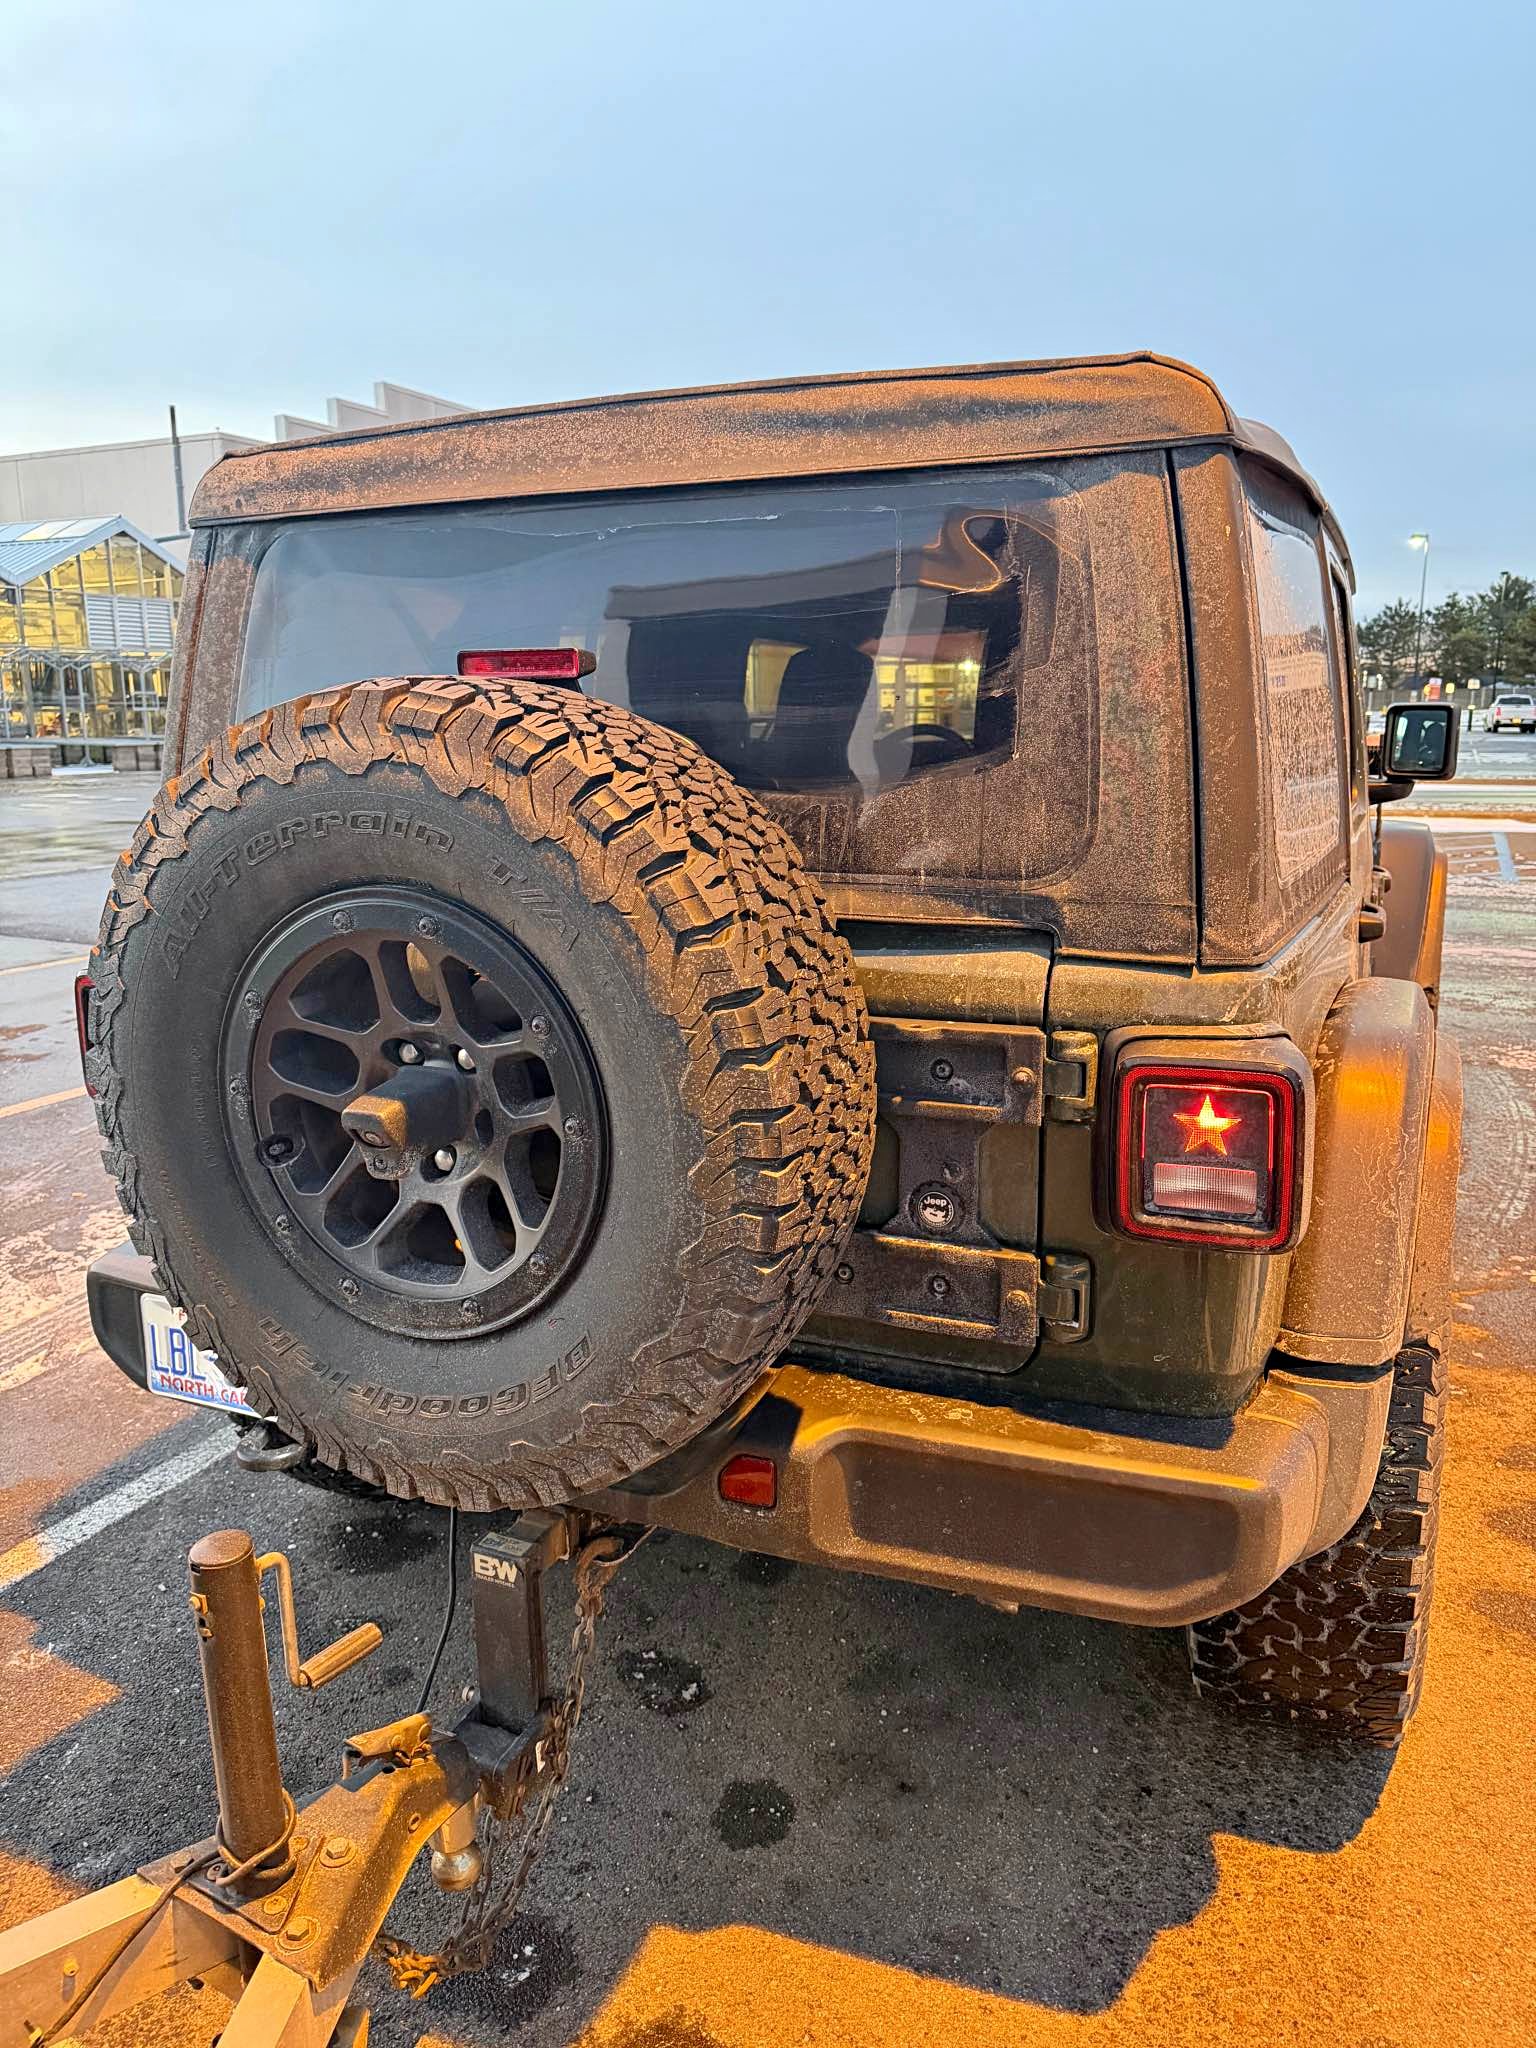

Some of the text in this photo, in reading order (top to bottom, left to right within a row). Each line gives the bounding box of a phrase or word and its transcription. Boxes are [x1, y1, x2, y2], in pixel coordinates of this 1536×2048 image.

[924, 1196, 947, 1208] Jeep
[257, 1315, 598, 1420] BFGoodrich
[160, 1375, 215, 1399] NORTH
